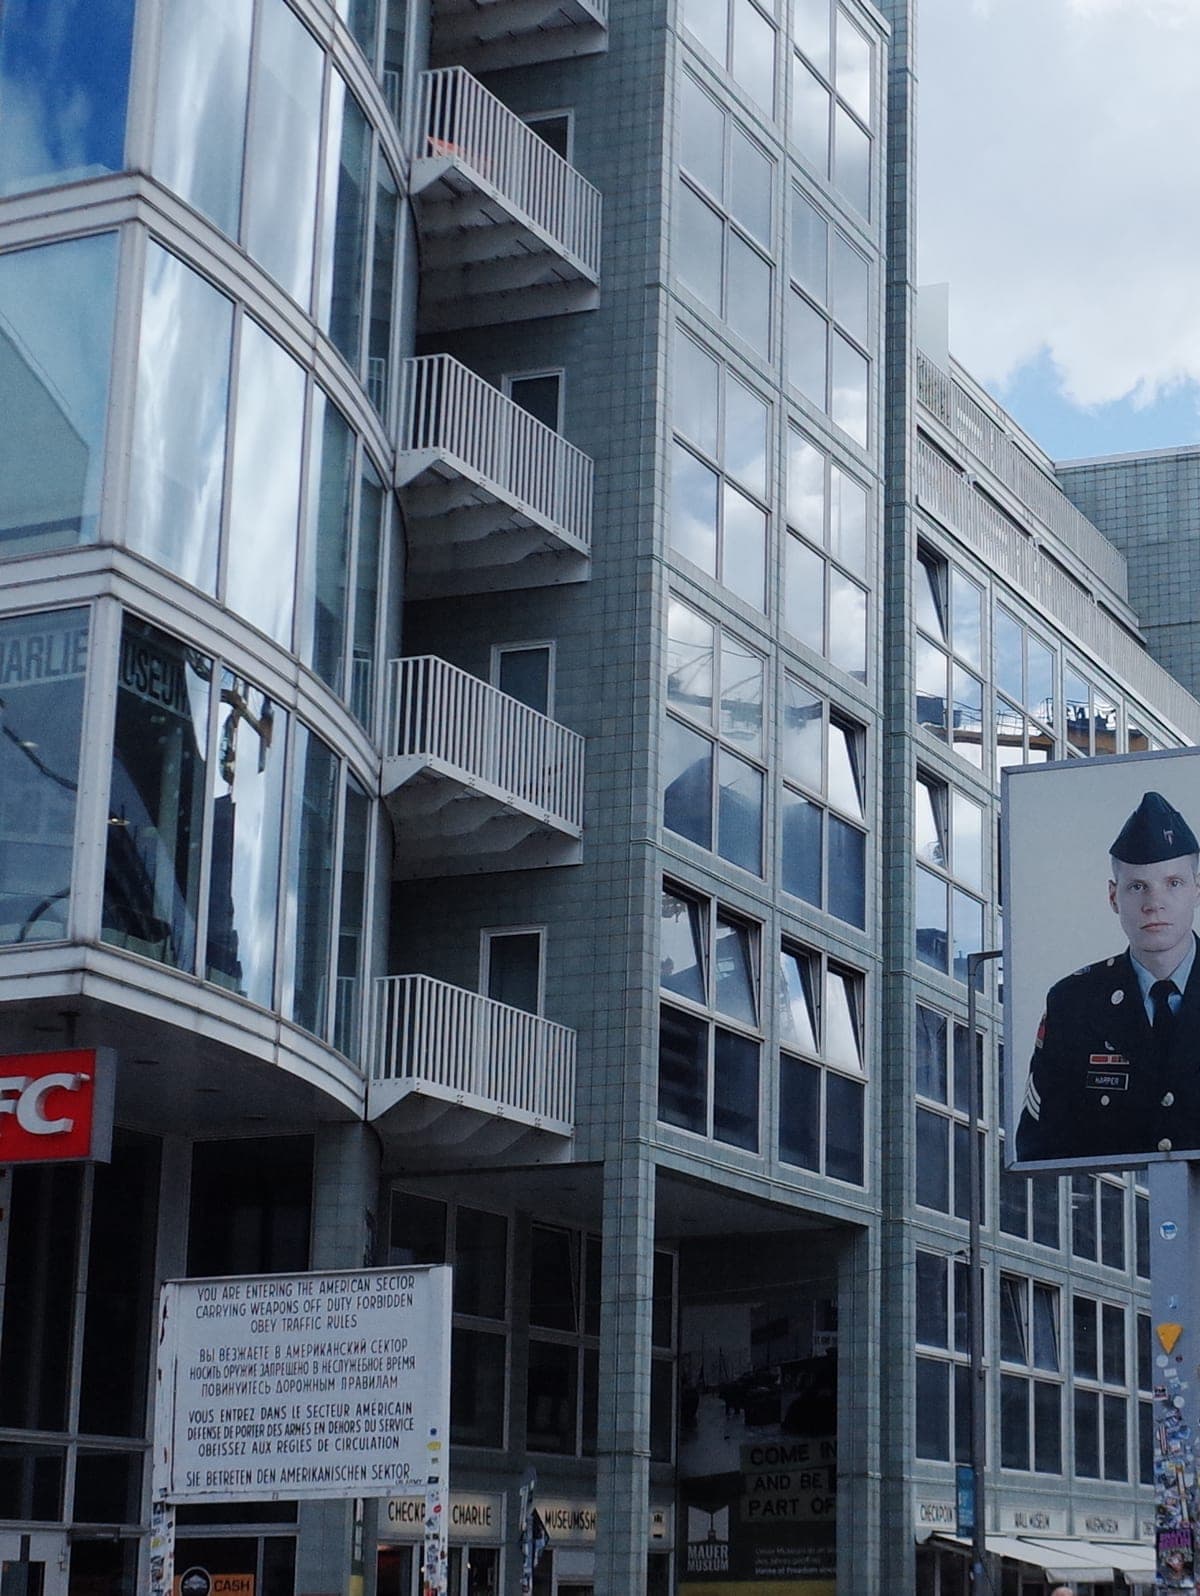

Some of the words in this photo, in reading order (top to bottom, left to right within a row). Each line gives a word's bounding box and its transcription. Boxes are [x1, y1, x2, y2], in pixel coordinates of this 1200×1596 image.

[197, 1287, 217, 1302] YOU
[222, 1285, 241, 1300] ARE
[246, 1282, 293, 1299] ENTERING
[298, 1281, 313, 1296] THE
[319, 1278, 370, 1295] AMERICAN
[375, 1275, 415, 1292] SECTOR
[195, 1303, 247, 1319] CARRYING
[250, 1299, 300, 1316] WEAPONS
[303, 1298, 322, 1314] OFF
[327, 1296, 353, 1312] DUTY
[356, 1293, 413, 1310] FORBIDDEN
[250, 1319, 278, 1333] OBEY
[282, 1316, 322, 1332] TRAFFIC
[327, 1314, 358, 1330] RULES
[199, 1348, 215, 1362] ВЫ
[274, 1344, 281, 1359] В
[286, 1338, 367, 1359] АМЕРИКАНСКИЙ
[370, 1338, 408, 1354] СЕКТОР
[189, 1365, 221, 1381] НОСИТЬ
[223, 1363, 257, 1379] ОРУЖИЕ
[313, 1360, 319, 1375] В
[386, 1355, 415, 1371] ВРЕМЯ
[276, 1377, 336, 1394] ДОРОЖНЫМ
[341, 1375, 398, 1391] ПРАВИЛАМ
[189, 1408, 215, 1424] VOUS
[220, 1407, 255, 1422] ENTREZ
[260, 1405, 287, 1420] DANS
[292, 1404, 301, 1419] LE
[306, 1403, 350, 1419] SECTEUR
[223, 1425, 233, 1439] DE
[235, 1423, 266, 1438] PORTER
[267, 1422, 283, 1437] DES
[284, 1421, 312, 1436] ARMES
[314, 1421, 325, 1435] EN
[328, 1419, 361, 1434] DEHORS
[364, 1419, 377, 1432] DU
[379, 1417, 414, 1432] SERVICE
[198, 1441, 246, 1457] OBEISSEZ
[252, 1440, 271, 1455] AUX
[317, 1438, 329, 1452] DE
[335, 1435, 400, 1452] CIRCULATION
[750, 1444, 810, 1466] COME
[186, 1471, 201, 1487] SIE
[206, 1469, 252, 1486] BETRETEN
[257, 1468, 276, 1484] DEN
[280, 1464, 367, 1483] AMERIKANISCHEN
[371, 1462, 410, 1480] SEKTOR
[754, 1474, 791, 1491] AND
[800, 1472, 823, 1490] BE
[452, 1504, 492, 1526] CHARLIE
[748, 1497, 800, 1517] PART
[920, 1503, 957, 1525] CHECKPOIN
[687, 1545, 729, 1560] MAUER
[687, 1559, 729, 1573] MUSEUM
[214, 1579, 250, 1593] CASH
